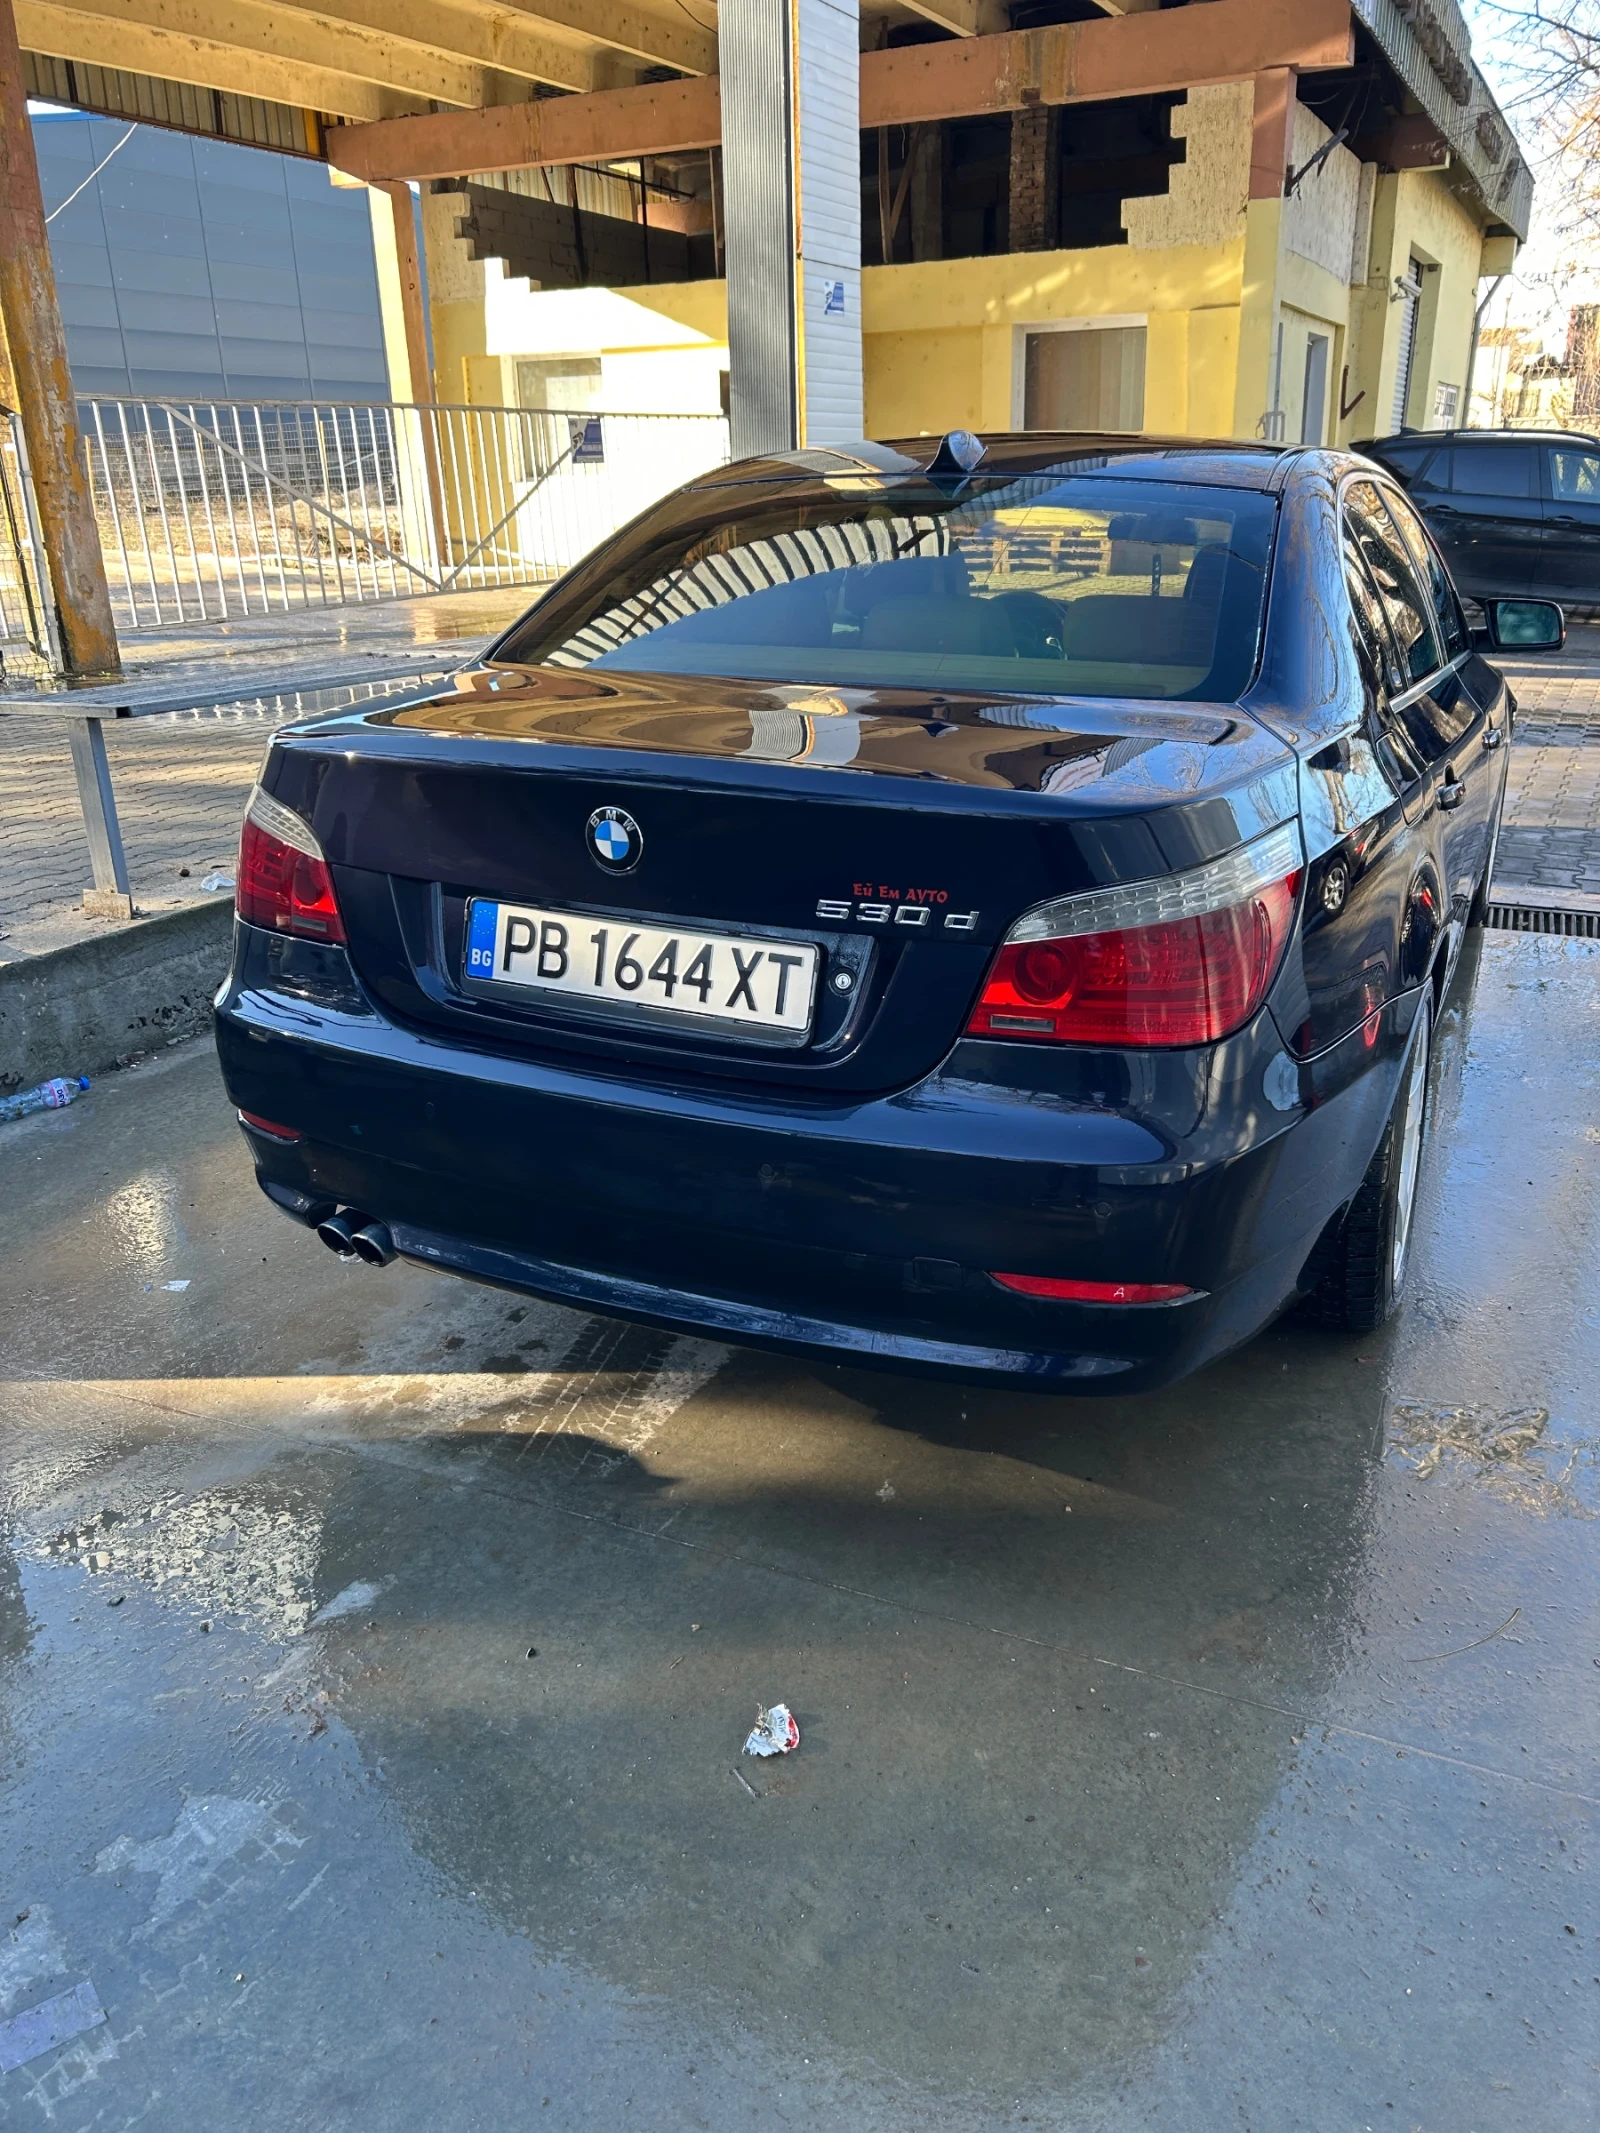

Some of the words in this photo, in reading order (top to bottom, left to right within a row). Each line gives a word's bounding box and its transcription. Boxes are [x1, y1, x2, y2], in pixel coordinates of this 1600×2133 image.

[590, 809, 636, 832] BMW
[815, 899, 931, 926] 530
[943, 910, 980, 931] d
[470, 948, 492, 967] BG
[502, 914, 570, 980] PB
[590, 928, 715, 1003] 1644
[724, 947, 803, 1016] XT
